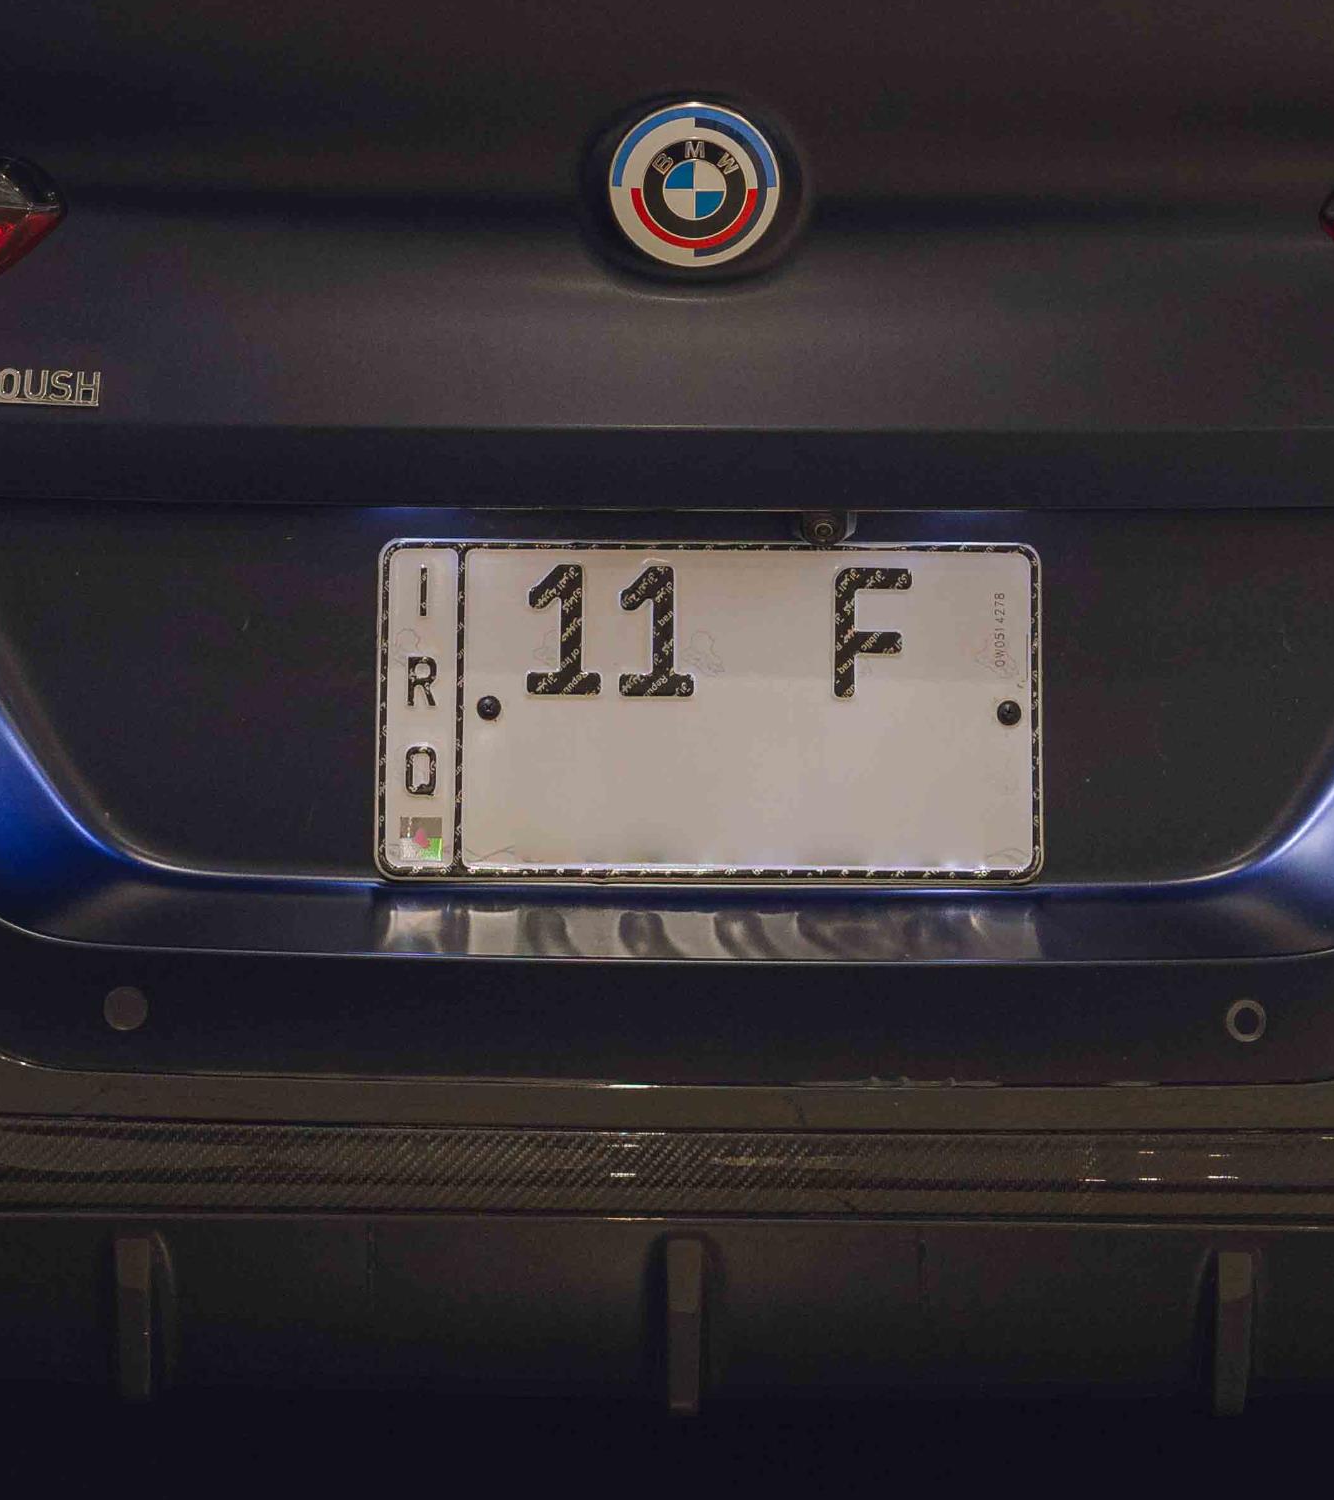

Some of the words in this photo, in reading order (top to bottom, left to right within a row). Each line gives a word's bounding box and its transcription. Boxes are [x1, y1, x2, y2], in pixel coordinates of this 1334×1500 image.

[652, 140, 740, 175] BMW
[526, 563, 696, 698] 11
[832, 567, 913, 699] F
